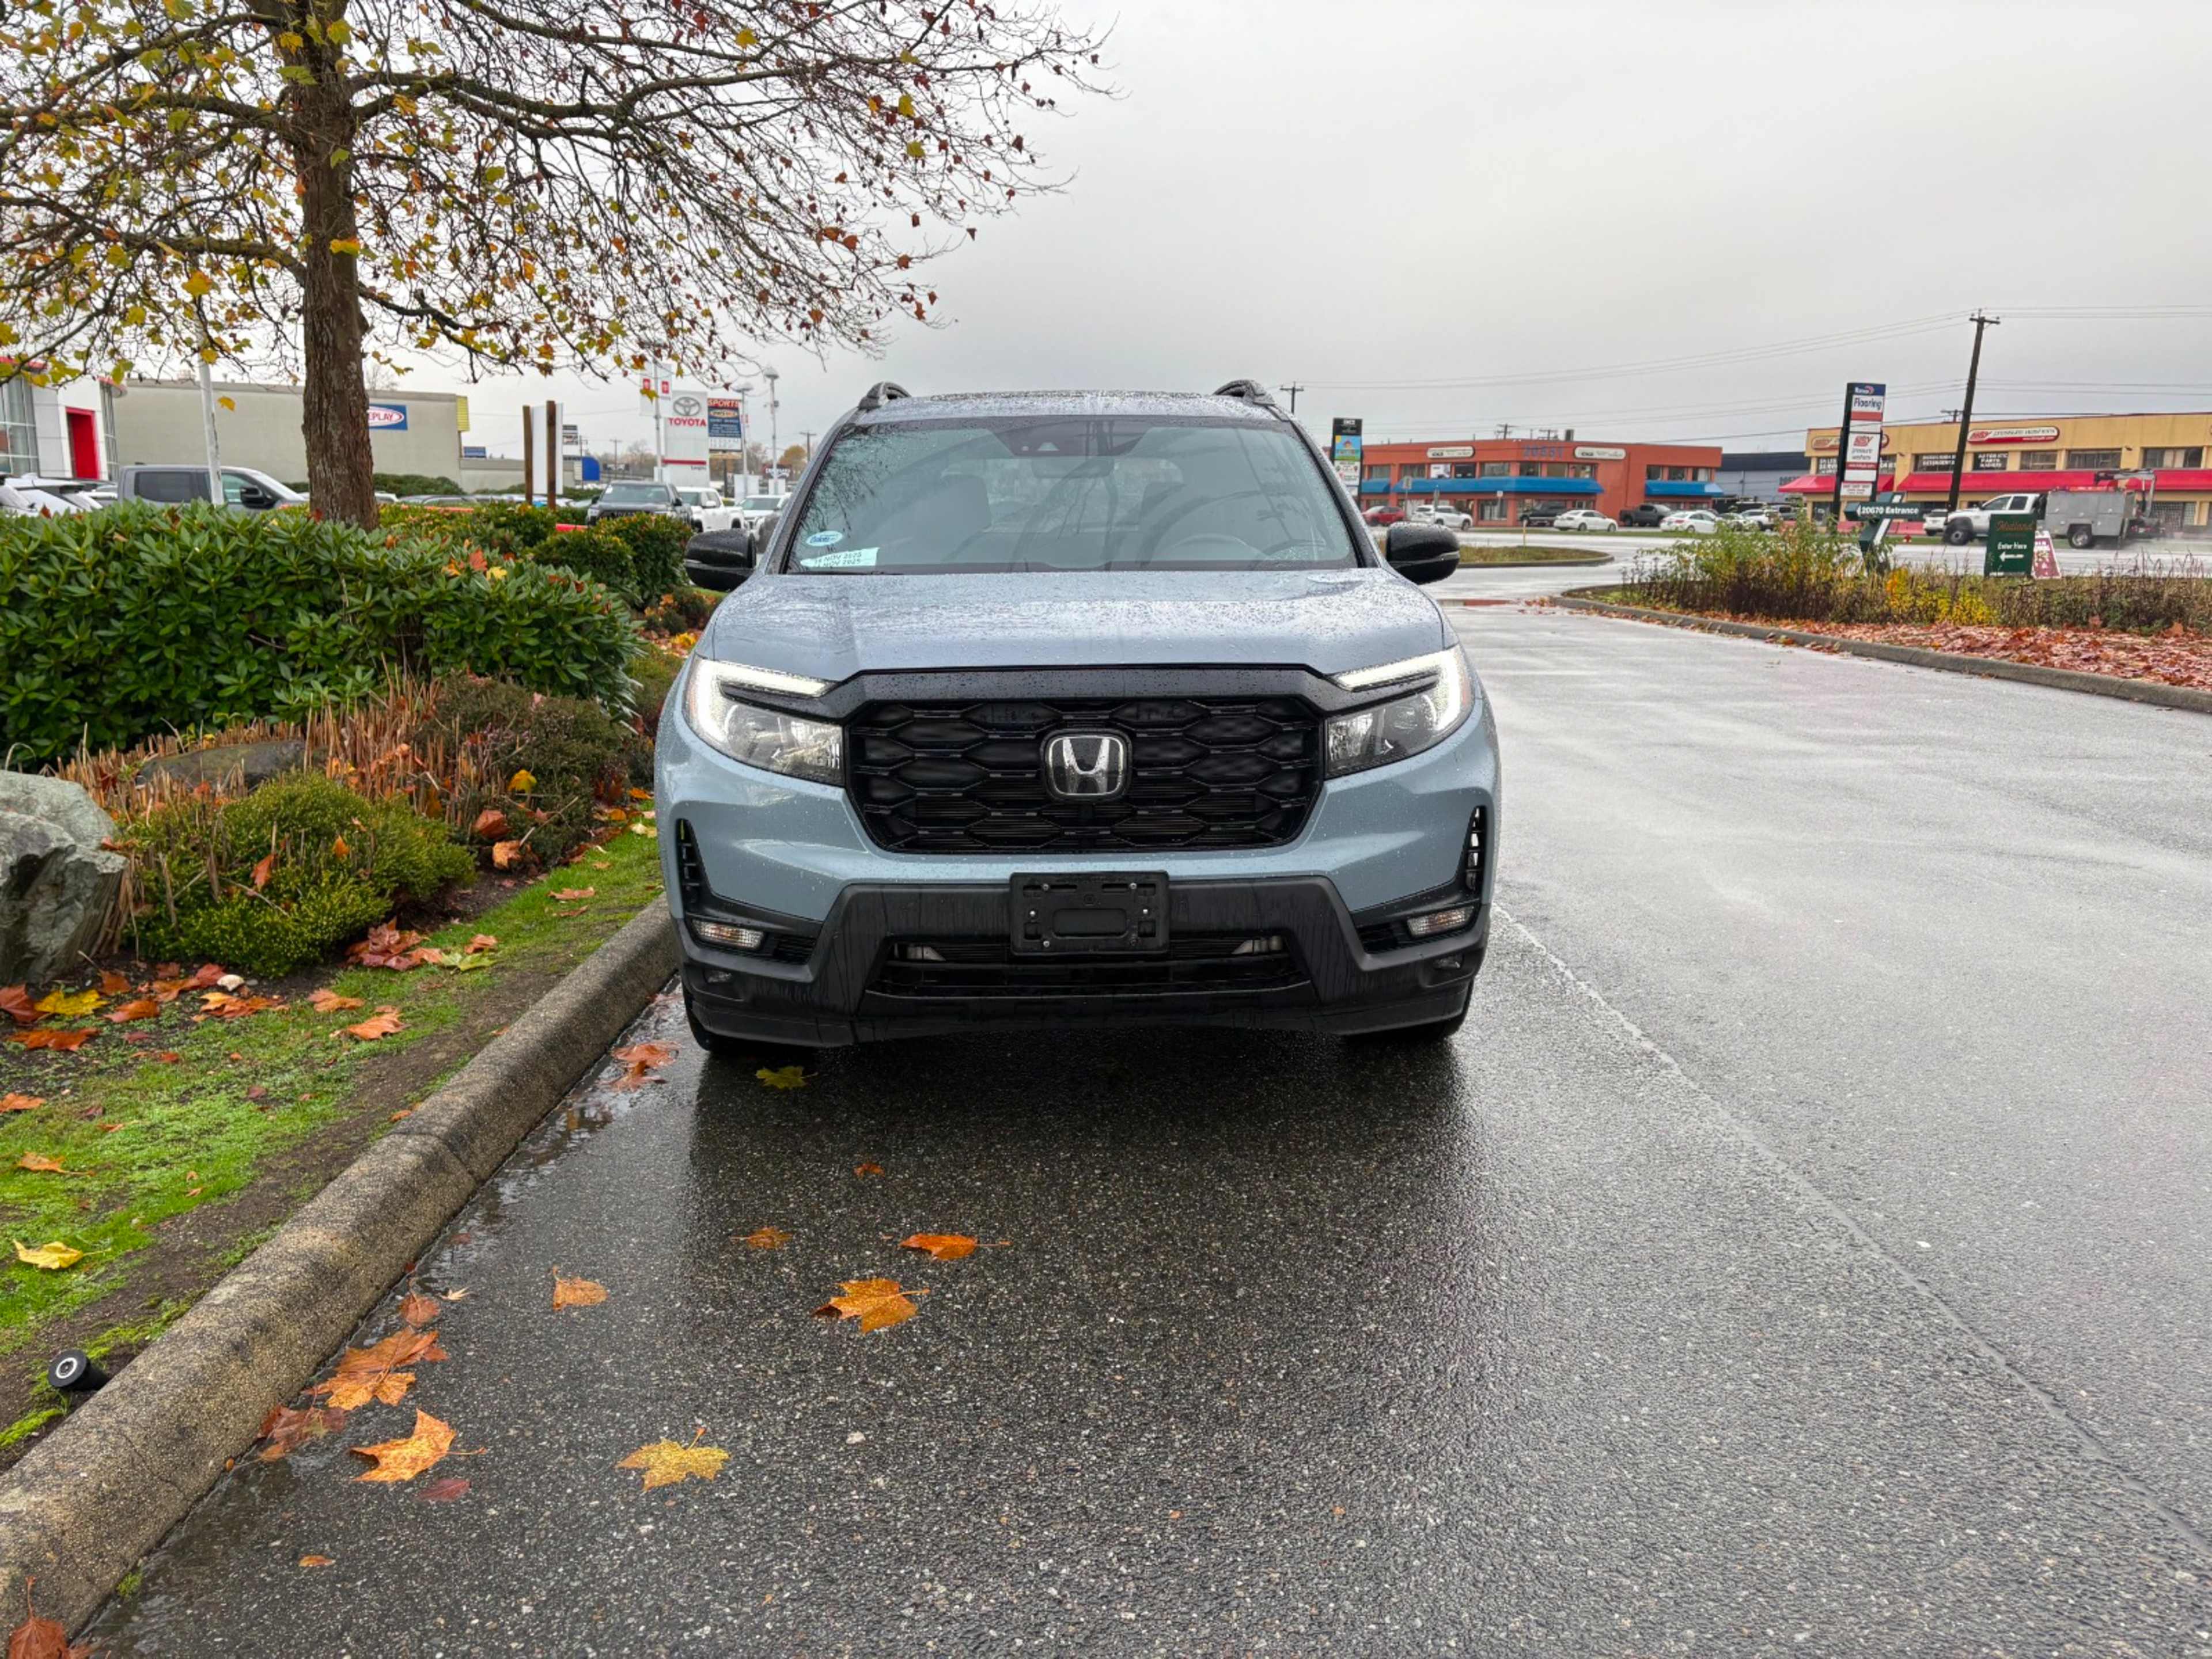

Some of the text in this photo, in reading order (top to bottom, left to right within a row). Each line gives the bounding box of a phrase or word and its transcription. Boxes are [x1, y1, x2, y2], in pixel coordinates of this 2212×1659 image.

[1854, 397, 1882, 410] Flooring
[369, 412, 393, 421] EPLAY
[668, 418, 706, 427] TOYOTA
[1885, 506, 1919, 515] Entrance
[1997, 541, 2012, 550] Enter
[2014, 541, 2027, 550] Here
